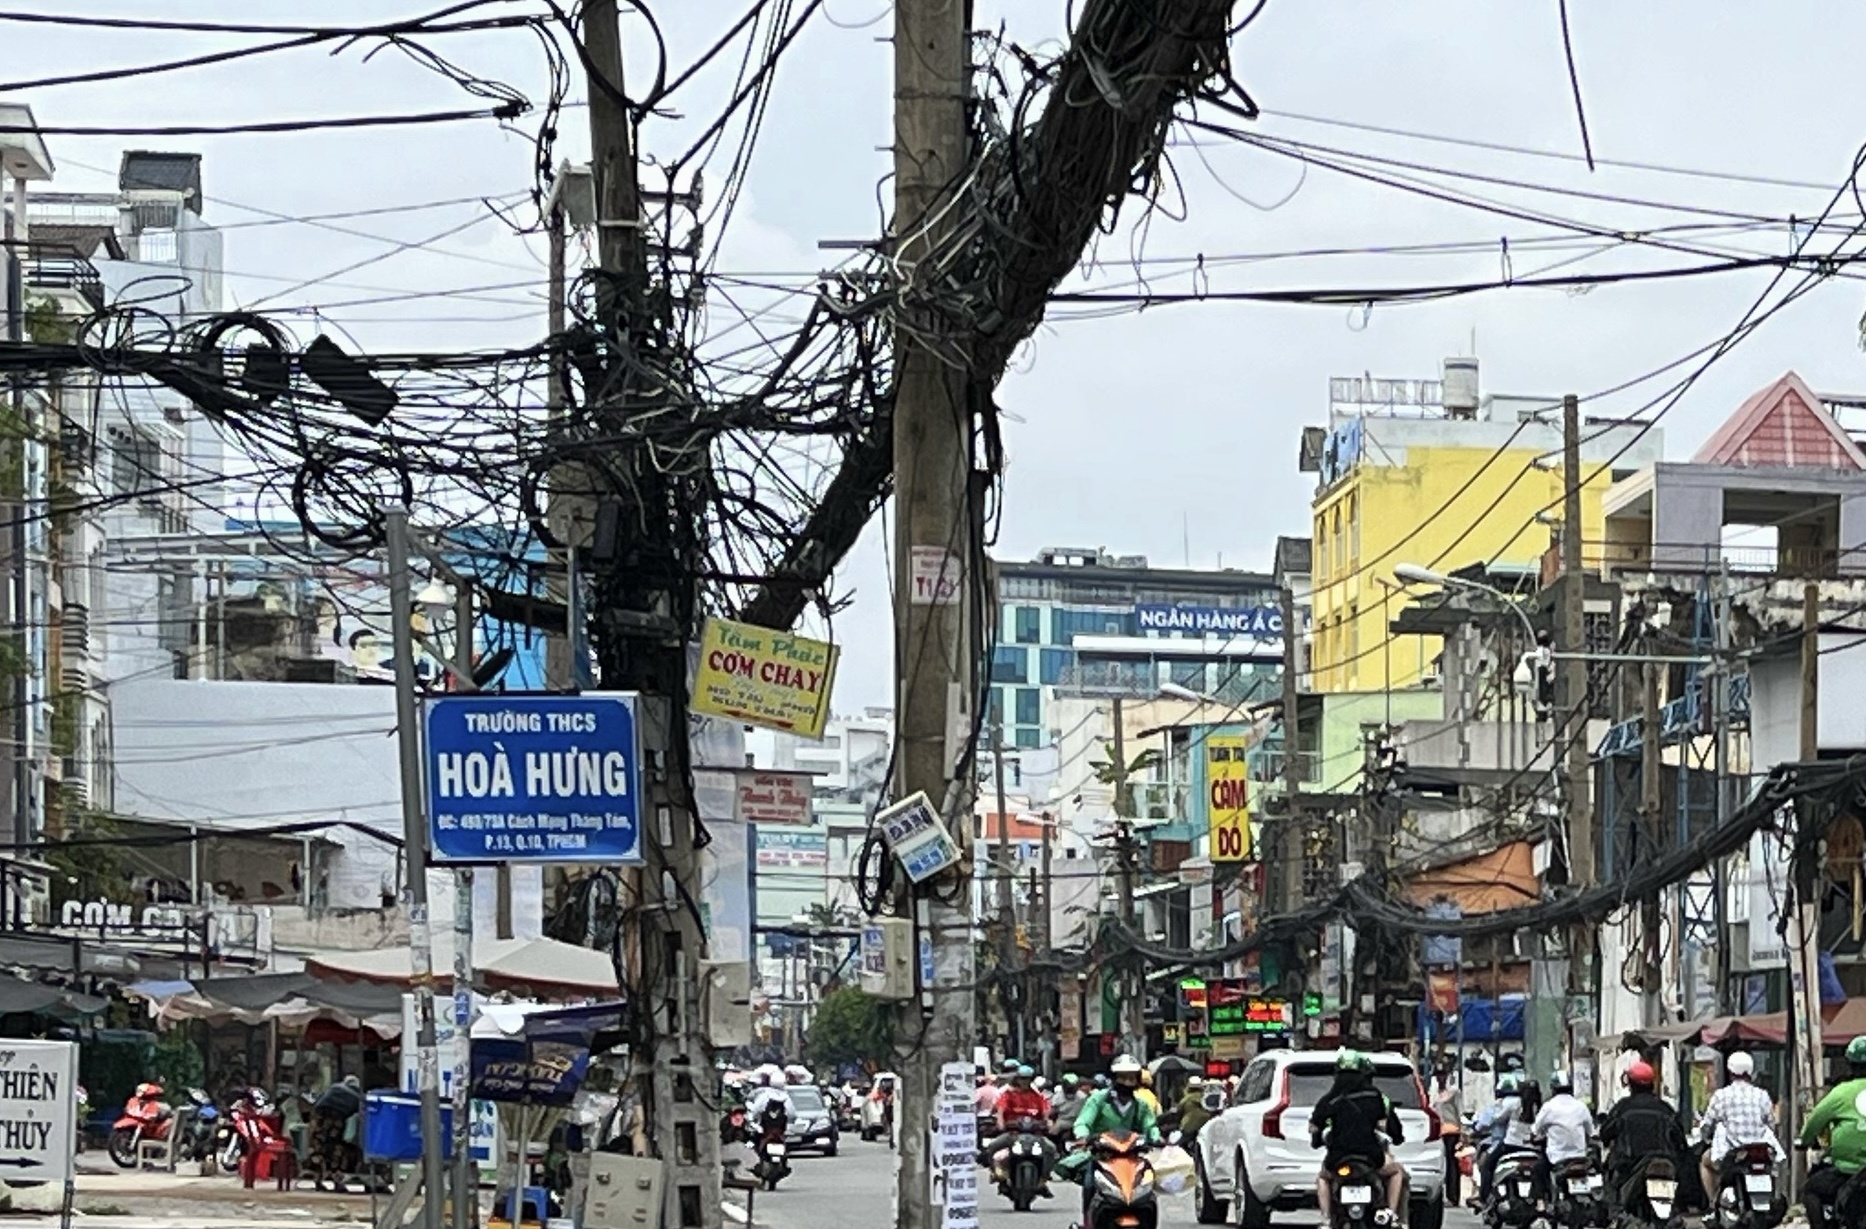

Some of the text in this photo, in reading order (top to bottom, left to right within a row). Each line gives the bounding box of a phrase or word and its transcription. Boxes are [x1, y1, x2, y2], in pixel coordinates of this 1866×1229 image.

[1140, 608, 1194, 629] NGÂN
[1196, 610, 1249, 631] HÀNG
[760, 661, 822, 693] CHAY
[464, 709, 596, 733] TRƯỜNG THCS
[437, 741, 628, 798] HOÀ HƯNG
